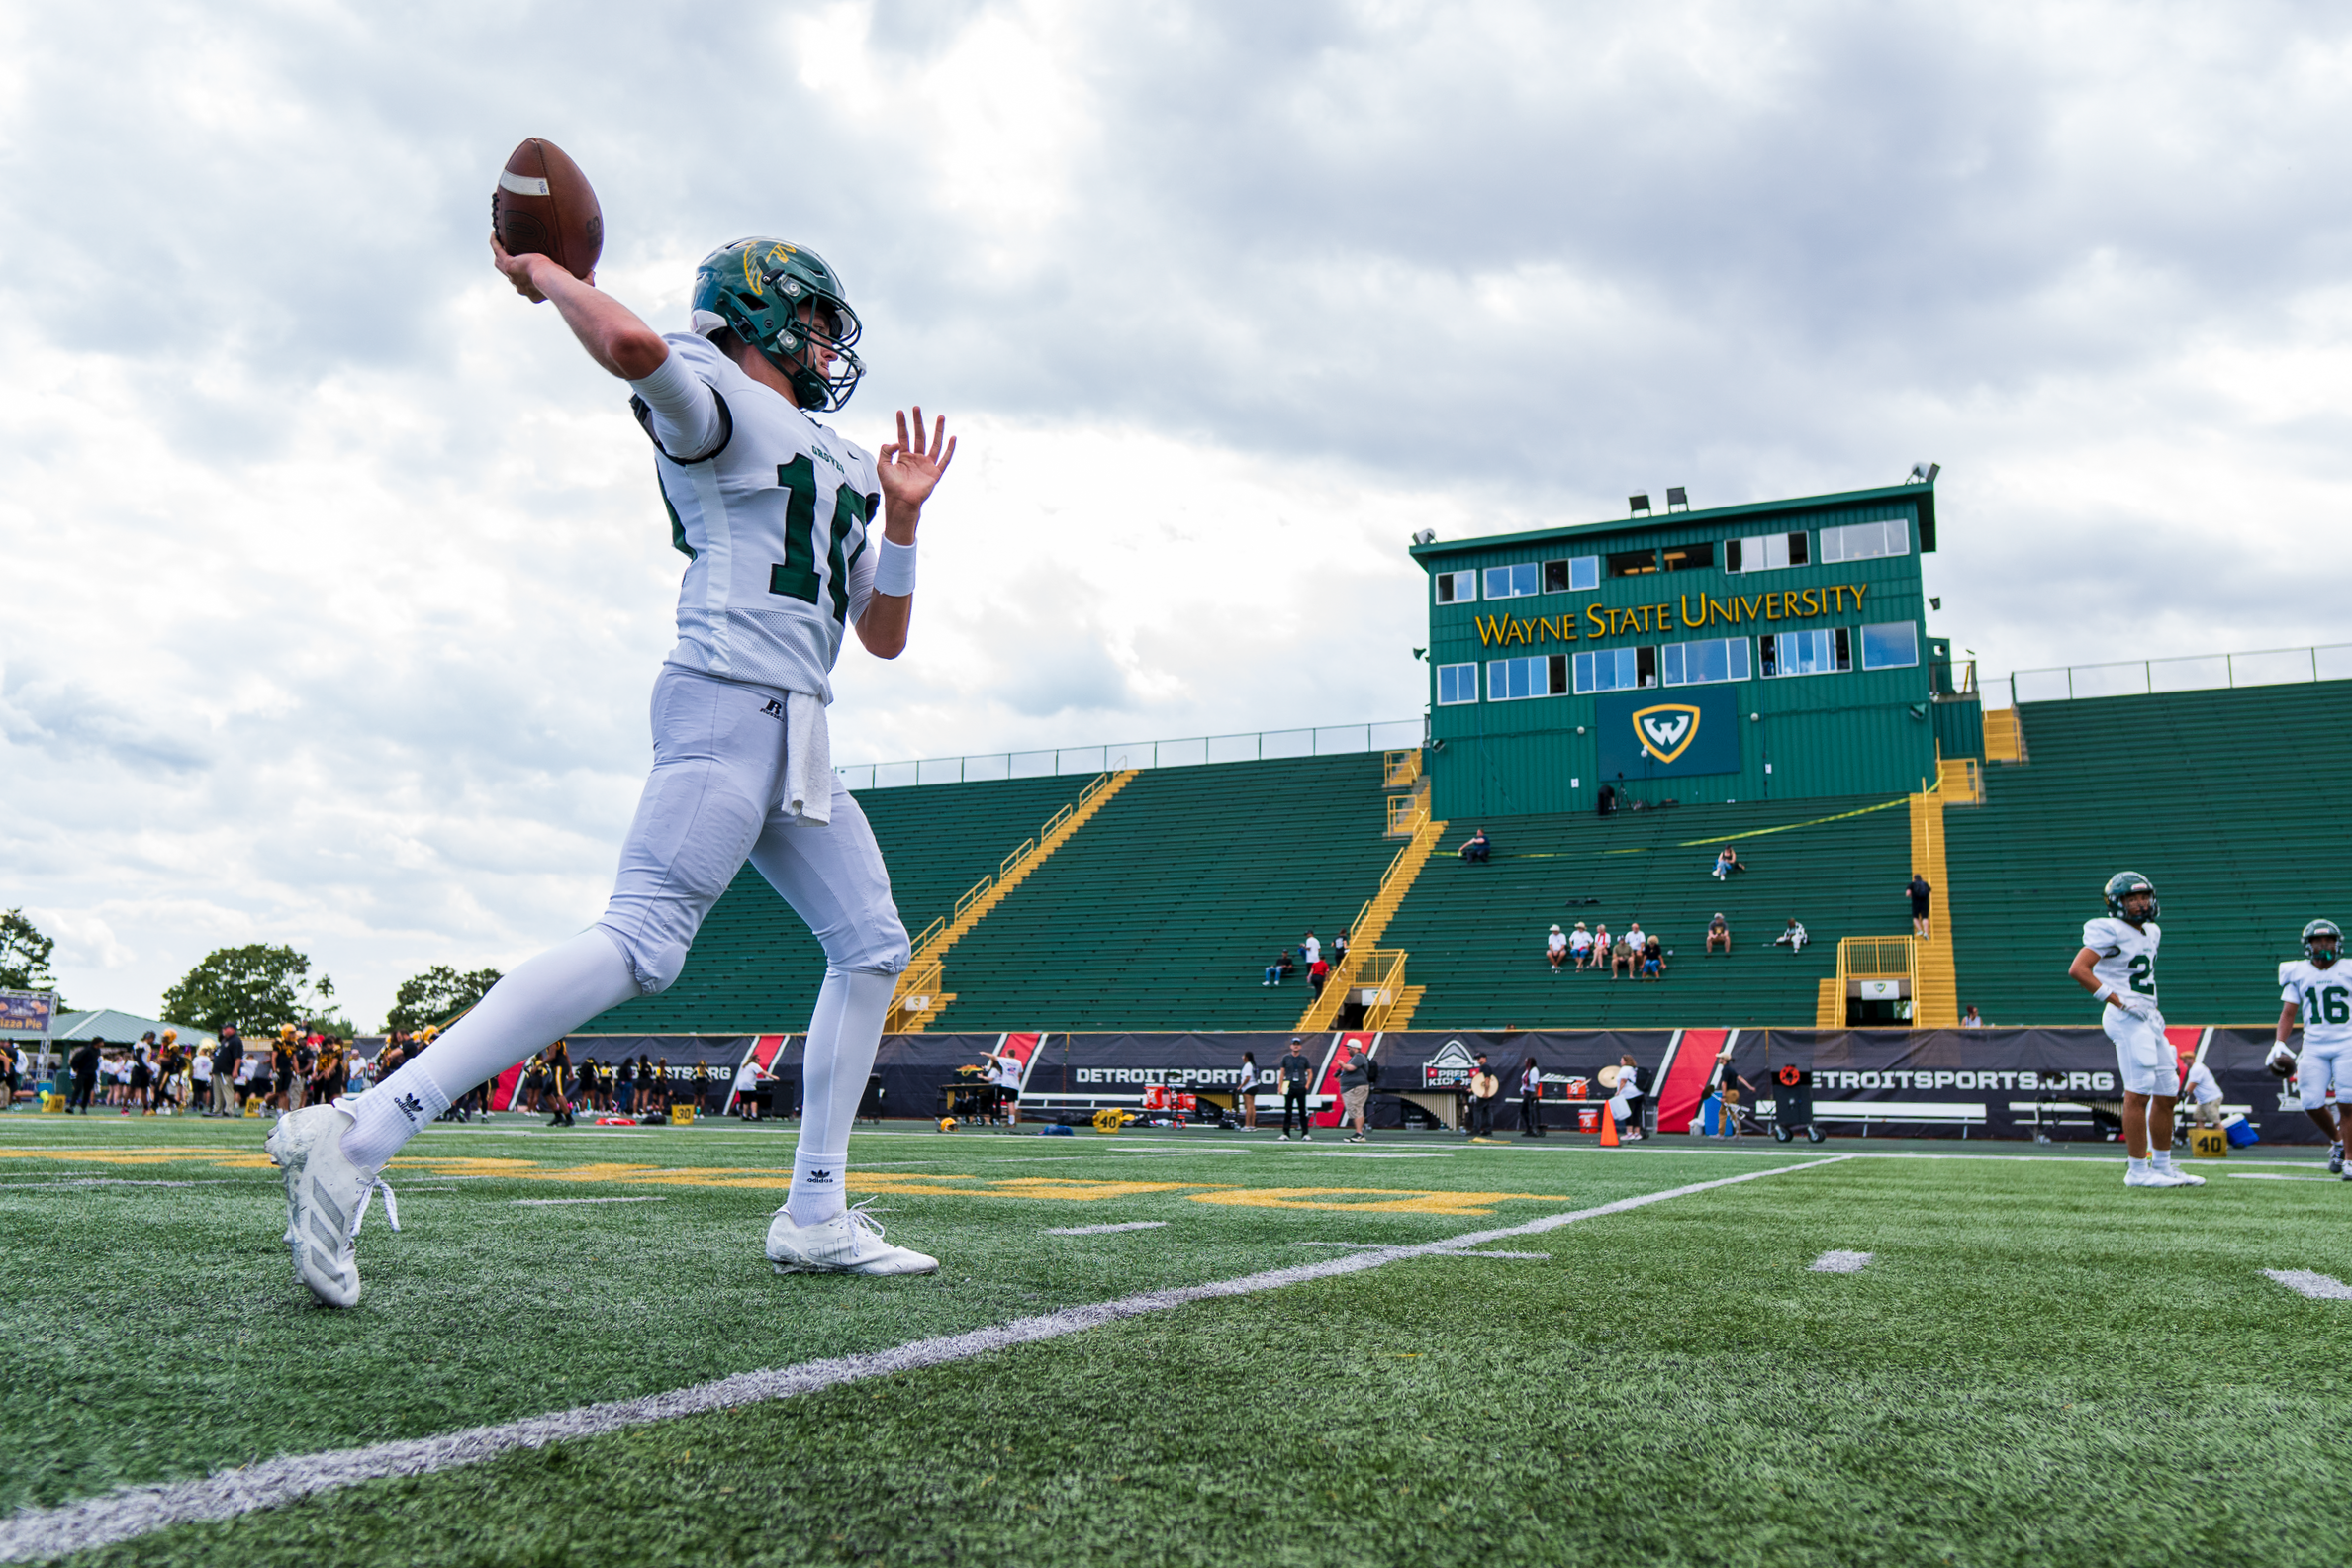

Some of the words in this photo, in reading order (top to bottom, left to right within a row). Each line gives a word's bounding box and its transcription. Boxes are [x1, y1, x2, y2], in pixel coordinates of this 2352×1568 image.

[769, 452, 867, 627] 10
[1474, 612, 1578, 647] WAYNE
[1586, 602, 1673, 639] STATE
[1681, 583, 1868, 628] UNIVERSITY
[1644, 715, 1689, 746] W
[2128, 955, 2157, 996] 2
[2305, 986, 2350, 1024] 16
[0, 1017, 22, 1029] izza
[25, 1018, 42, 1029] Pie
[1438, 1069, 1469, 1078] PREP
[1812, 1070, 2115, 1091] ETROITSPORTS.ORG
[394, 1096, 417, 1122] adidas
[1100, 1115, 1117, 1129] 40
[2198, 1136, 2222, 1153] 40
